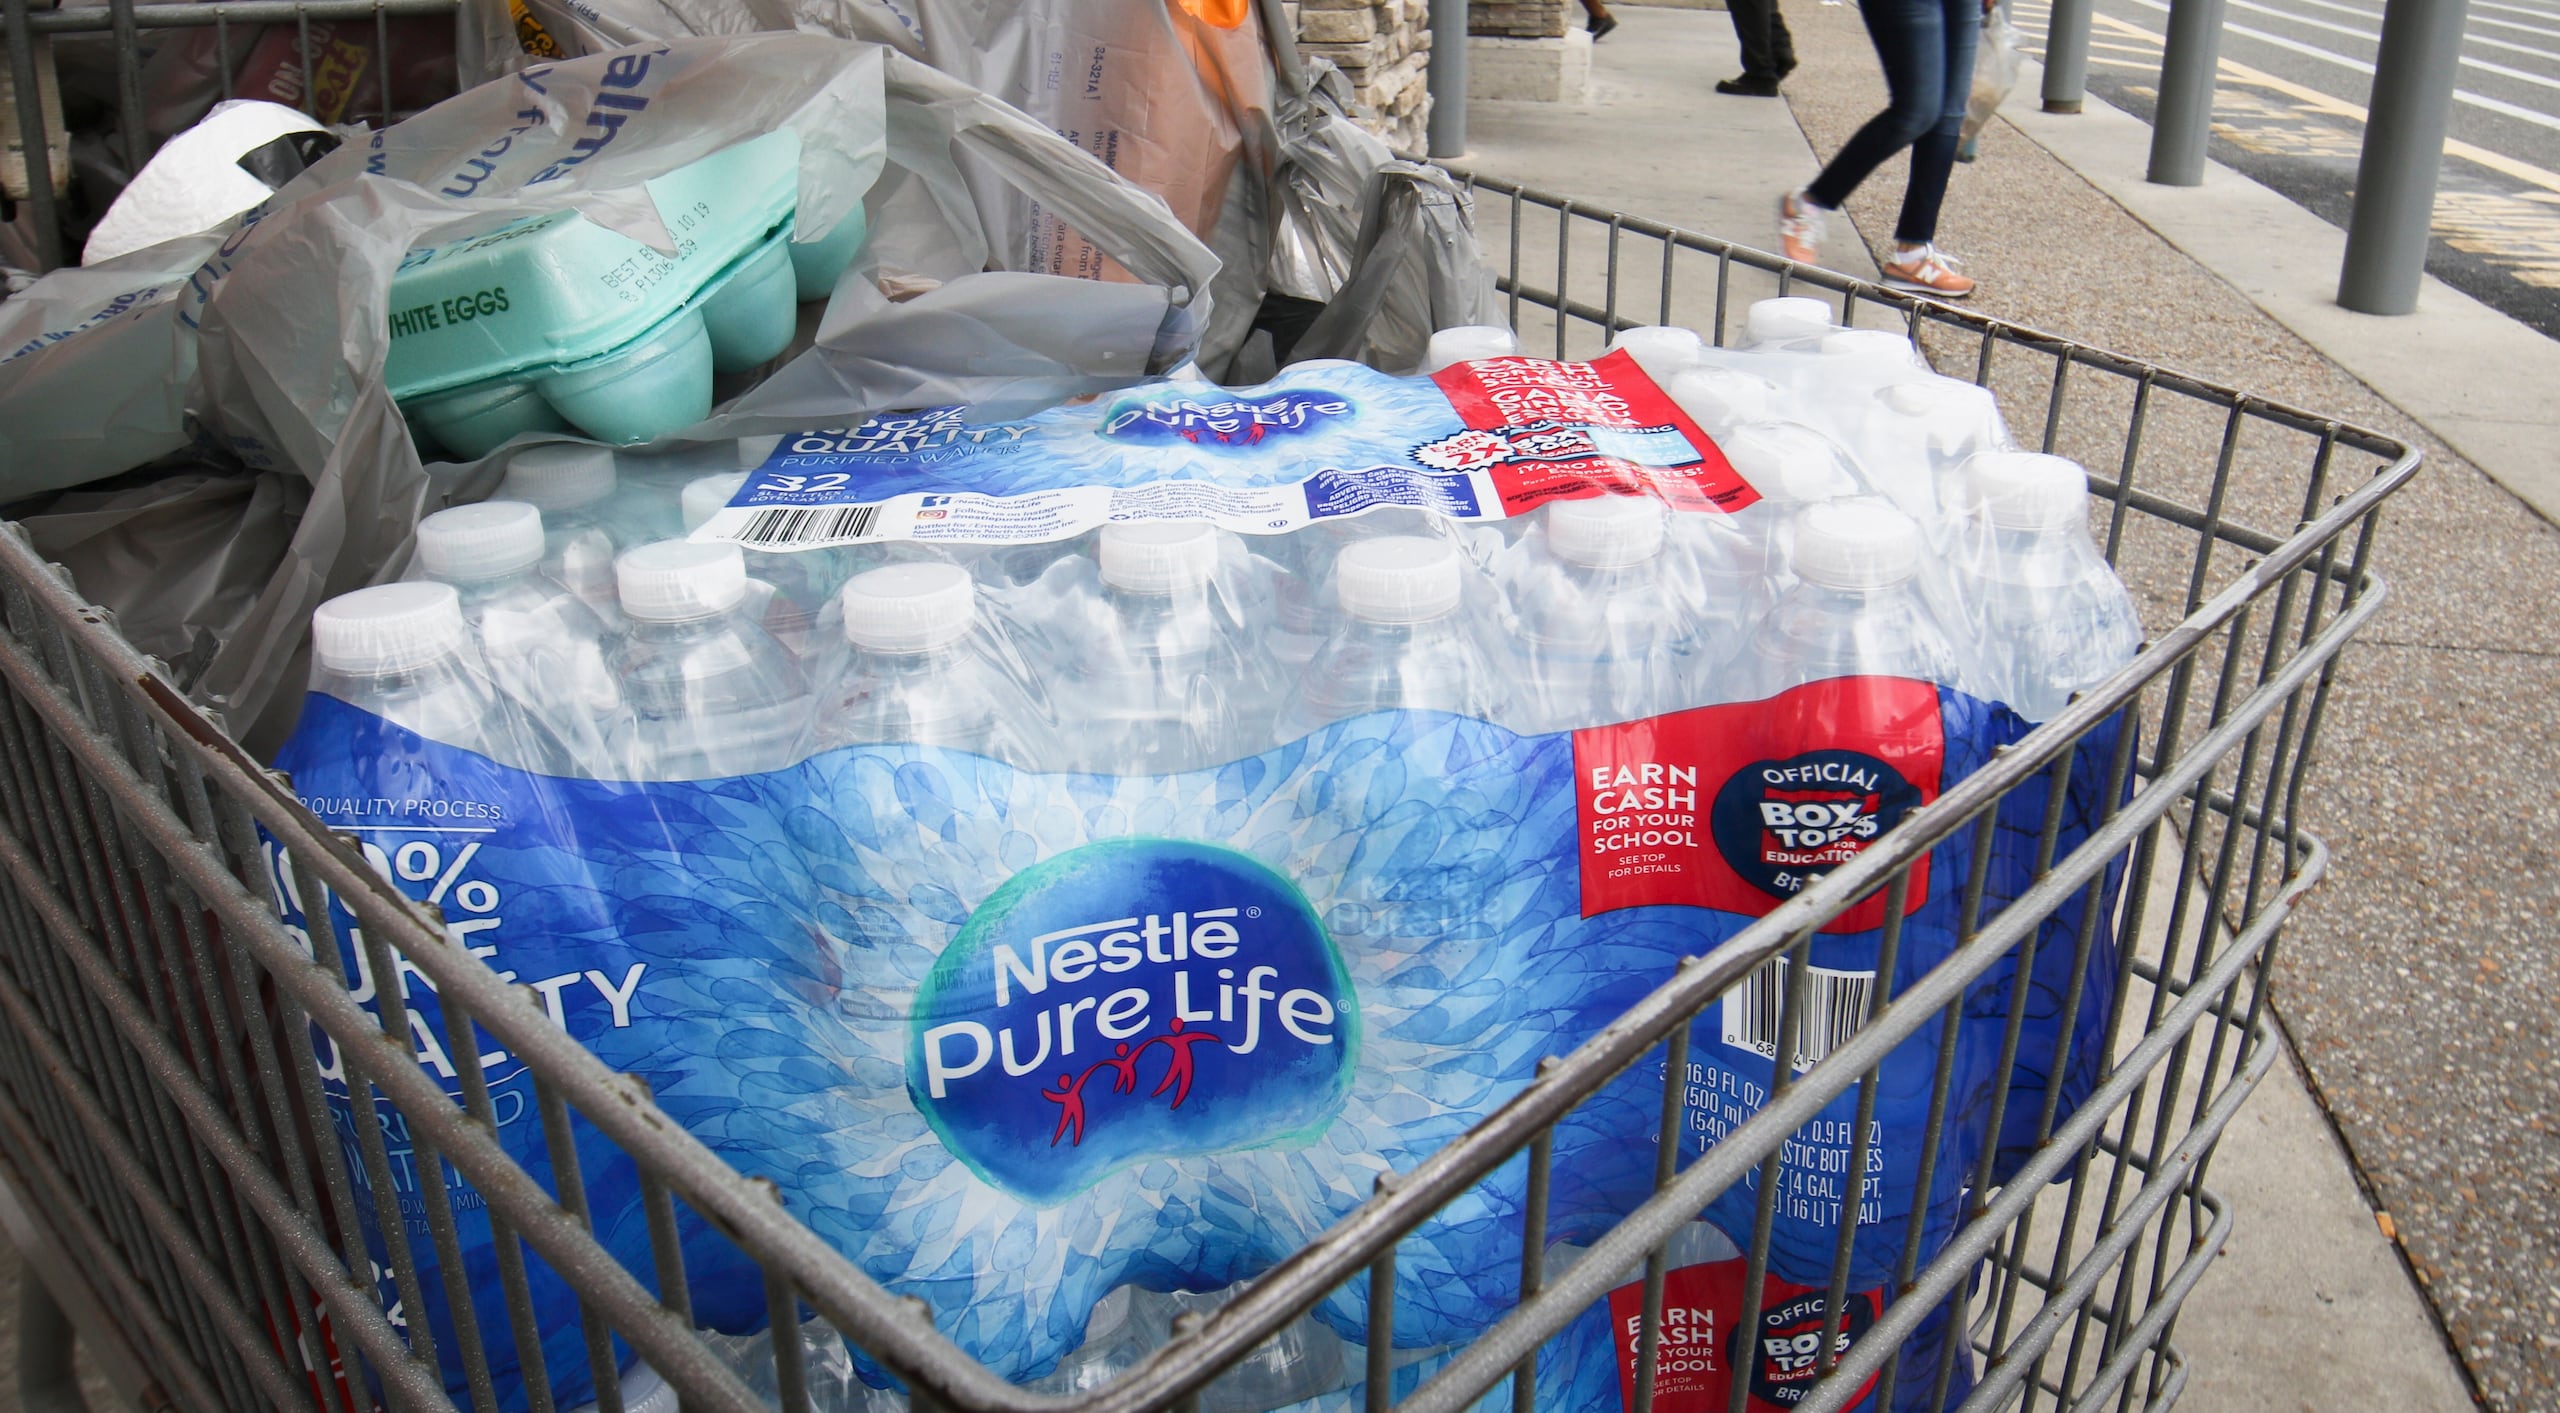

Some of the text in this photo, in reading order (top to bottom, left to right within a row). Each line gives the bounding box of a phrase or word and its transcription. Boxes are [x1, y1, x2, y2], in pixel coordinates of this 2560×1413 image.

[1078, 246, 1092, 272] from
[600, 258, 640, 289] BEST
[442, 286, 509, 325] EGGS
[1482, 375, 1613, 388] SCHOOL
[1490, 388, 1624, 403] GANA
[1105, 401, 1350, 434] Pure Life
[790, 425, 1040, 454] QUALITY
[780, 455, 910, 468] PURIFIED
[1445, 442, 1510, 466] 2X
[756, 472, 852, 493] 32
[1592, 763, 1697, 790] EARN
[1763, 763, 1879, 791] OFFICIAL
[312, 797, 400, 818] QUALITY
[404, 799, 502, 820] PROCESS
[1593, 787, 1696, 814] CASH
[1593, 813, 1695, 834] FOR YOUR
[1759, 802, 1863, 828] BOX
[1594, 830, 1699, 854] SCHOOL
[1833, 841, 1857, 849] FOR
[1619, 853, 1666, 866] SEE TOP
[1766, 849, 1861, 864] EDUCATIO
[1608, 864, 1682, 879] FOR DETAILS
[993, 907, 1240, 1006] Nestlé
[923, 965, 1336, 1099] Pure Life
[1683, 1085, 1719, 1114] (500
[1686, 1063, 1765, 1112] 16.9 FL OZ
[1812, 1121, 1833, 1144] 0.9
[1627, 1307, 1714, 1336] ERN
[1665, 1347, 1713, 1358] YOUR
[1763, 1331, 1822, 1356] BO
[1666, 1384, 1705, 1394] DETAILS
[1672, 1376, 1692, 1384] TOP
